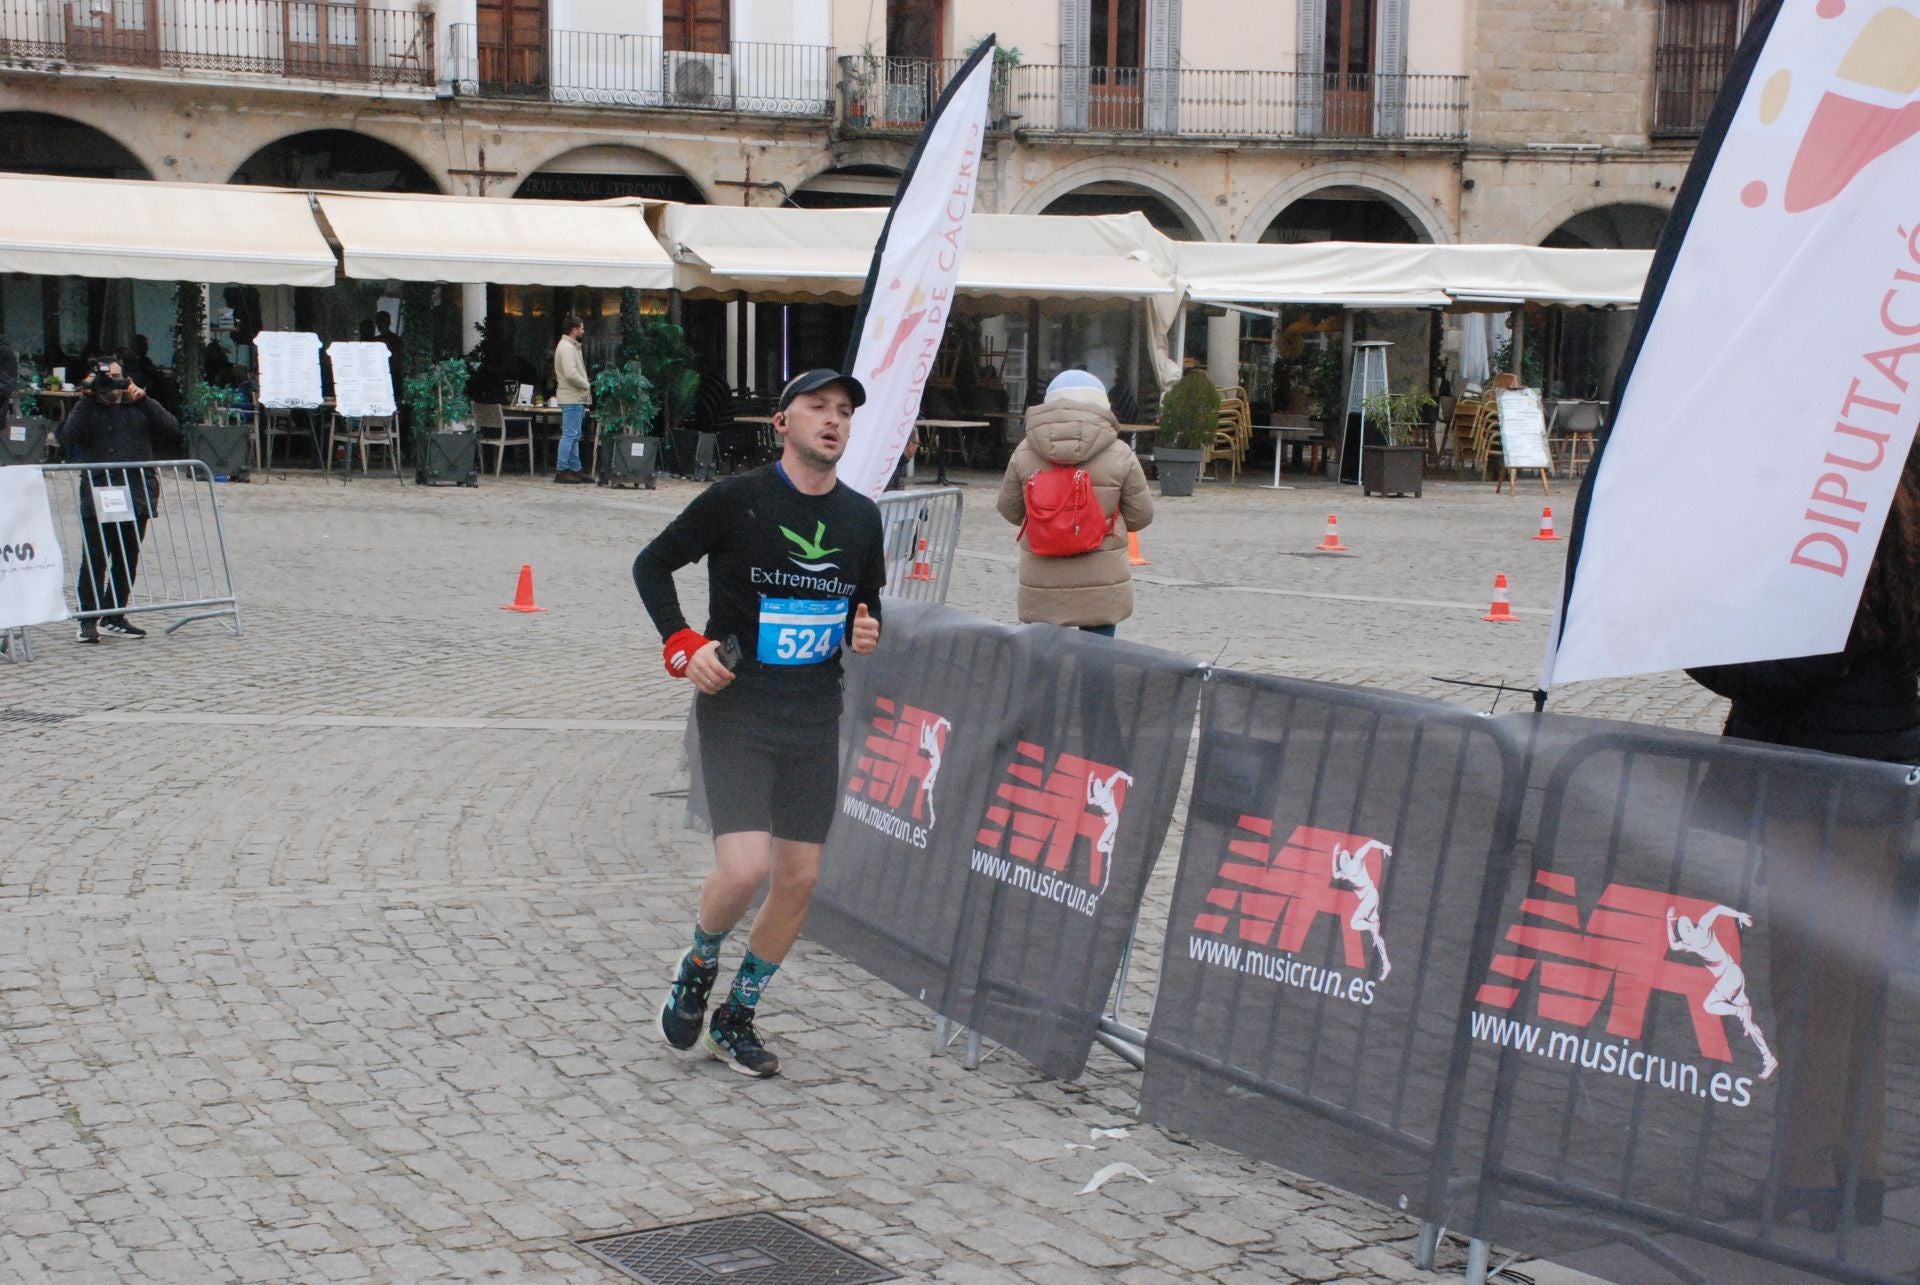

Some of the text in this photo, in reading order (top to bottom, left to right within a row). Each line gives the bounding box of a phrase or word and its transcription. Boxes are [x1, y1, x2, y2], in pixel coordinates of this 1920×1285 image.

[927, 286, 948, 325] DE
[1790, 224, 1920, 578] DIPUTACI
[776, 628, 832, 660] 524
[842, 794, 928, 849] www.musicrun.es
[1189, 936, 1376, 1005] www.musicrun.es
[1471, 1011, 1753, 1107] www.musicrun.es
